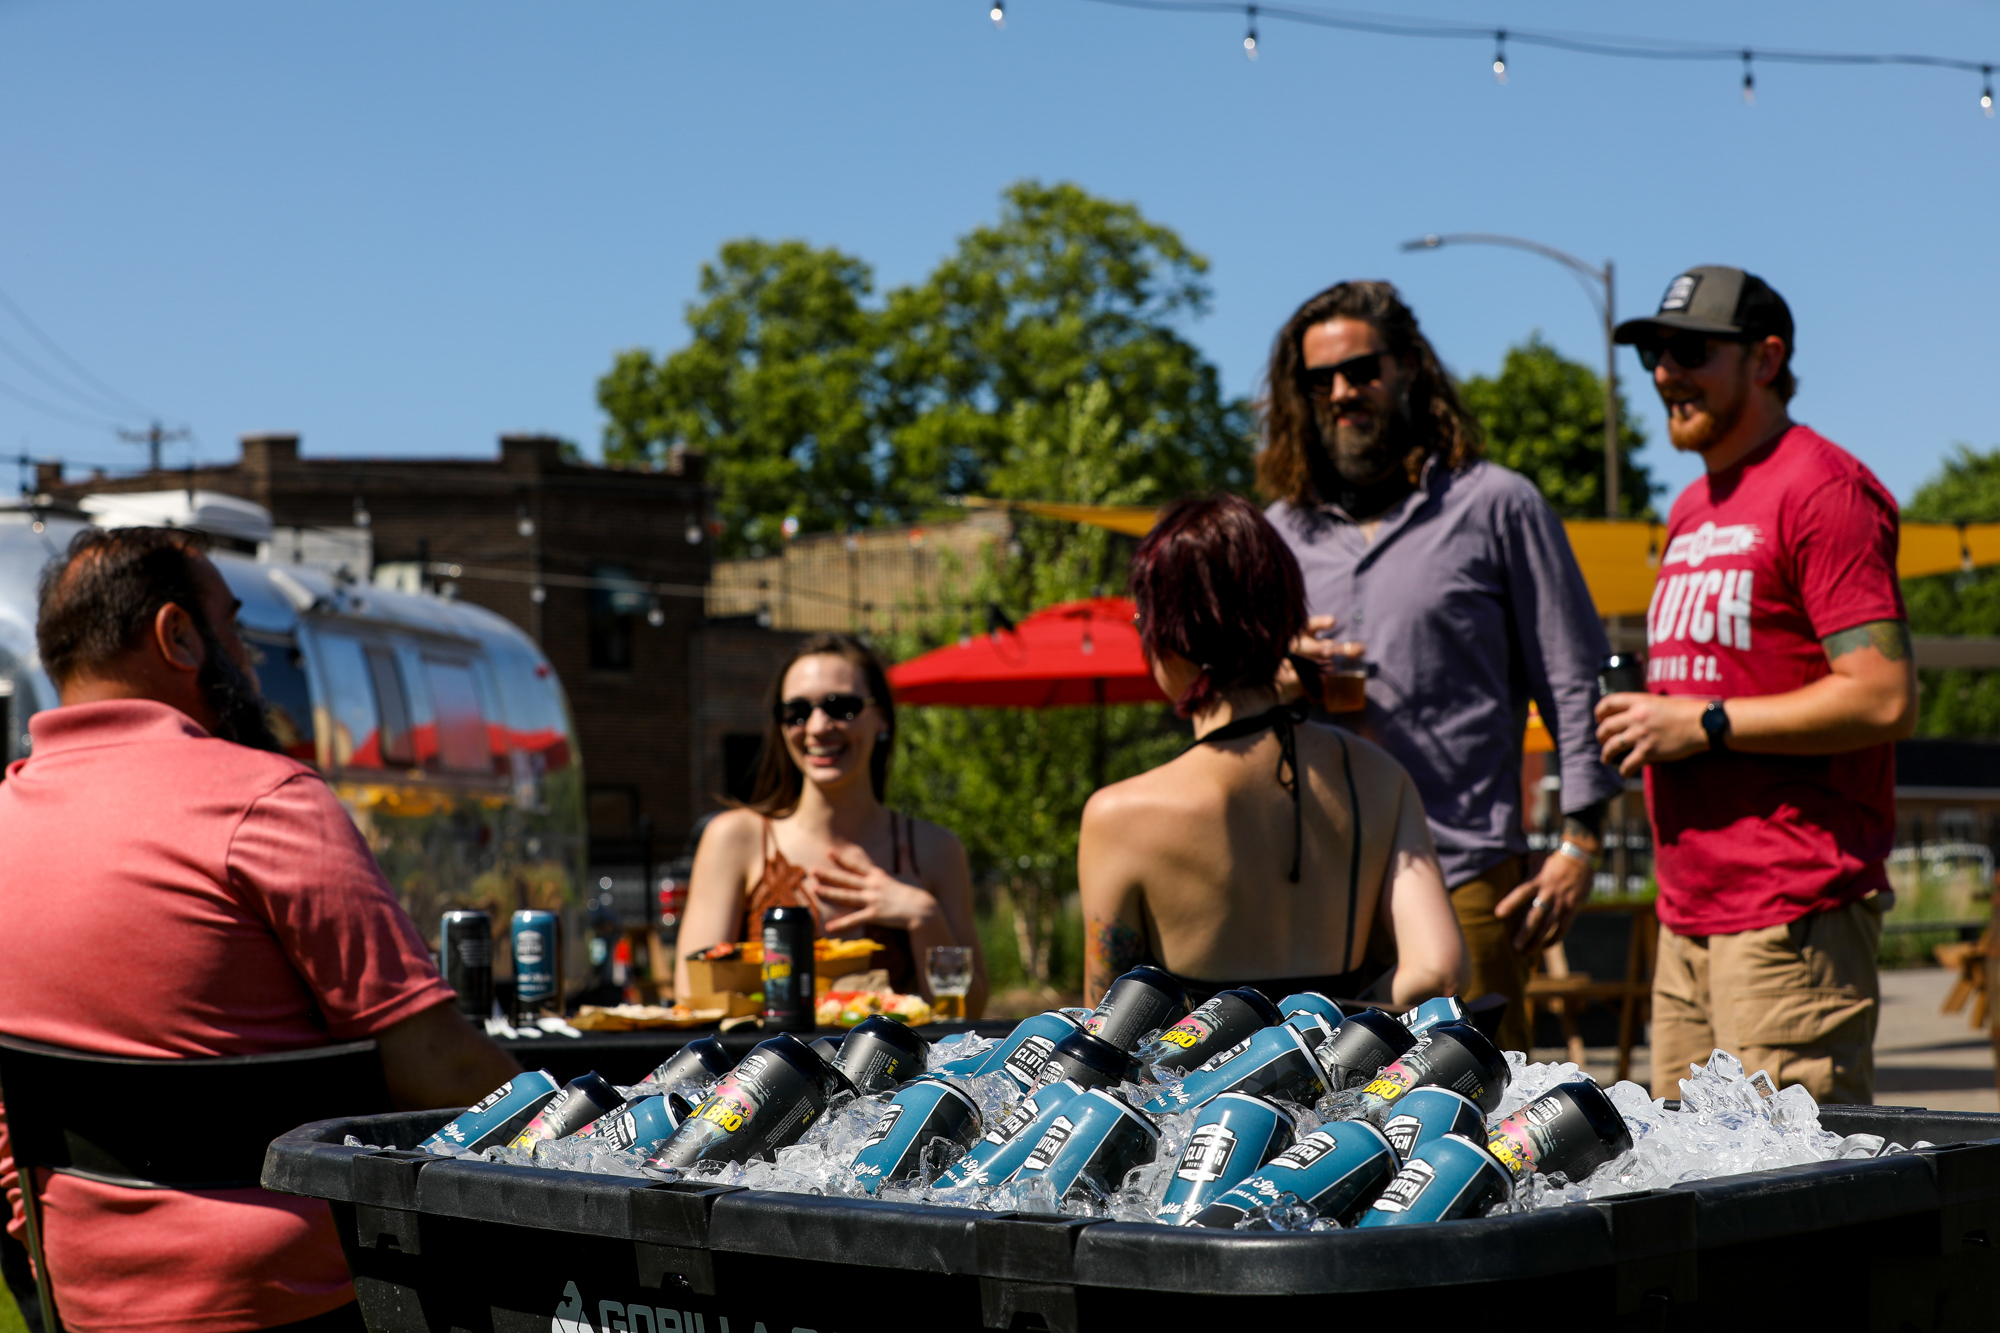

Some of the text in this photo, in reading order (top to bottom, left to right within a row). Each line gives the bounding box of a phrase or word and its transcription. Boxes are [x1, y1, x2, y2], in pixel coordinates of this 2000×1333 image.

[1647, 568, 1754, 652] LUTCH
[1692, 654, 1722, 682] CO.
[1159, 1030, 1198, 1048] BRO
[1014, 1047, 1046, 1074] CLUT
[1362, 1080, 1402, 1100] BRO
[703, 1104, 743, 1132] BRO
[1389, 1134, 1412, 1150] TCH
[1247, 1194, 1264, 1207] ALE
